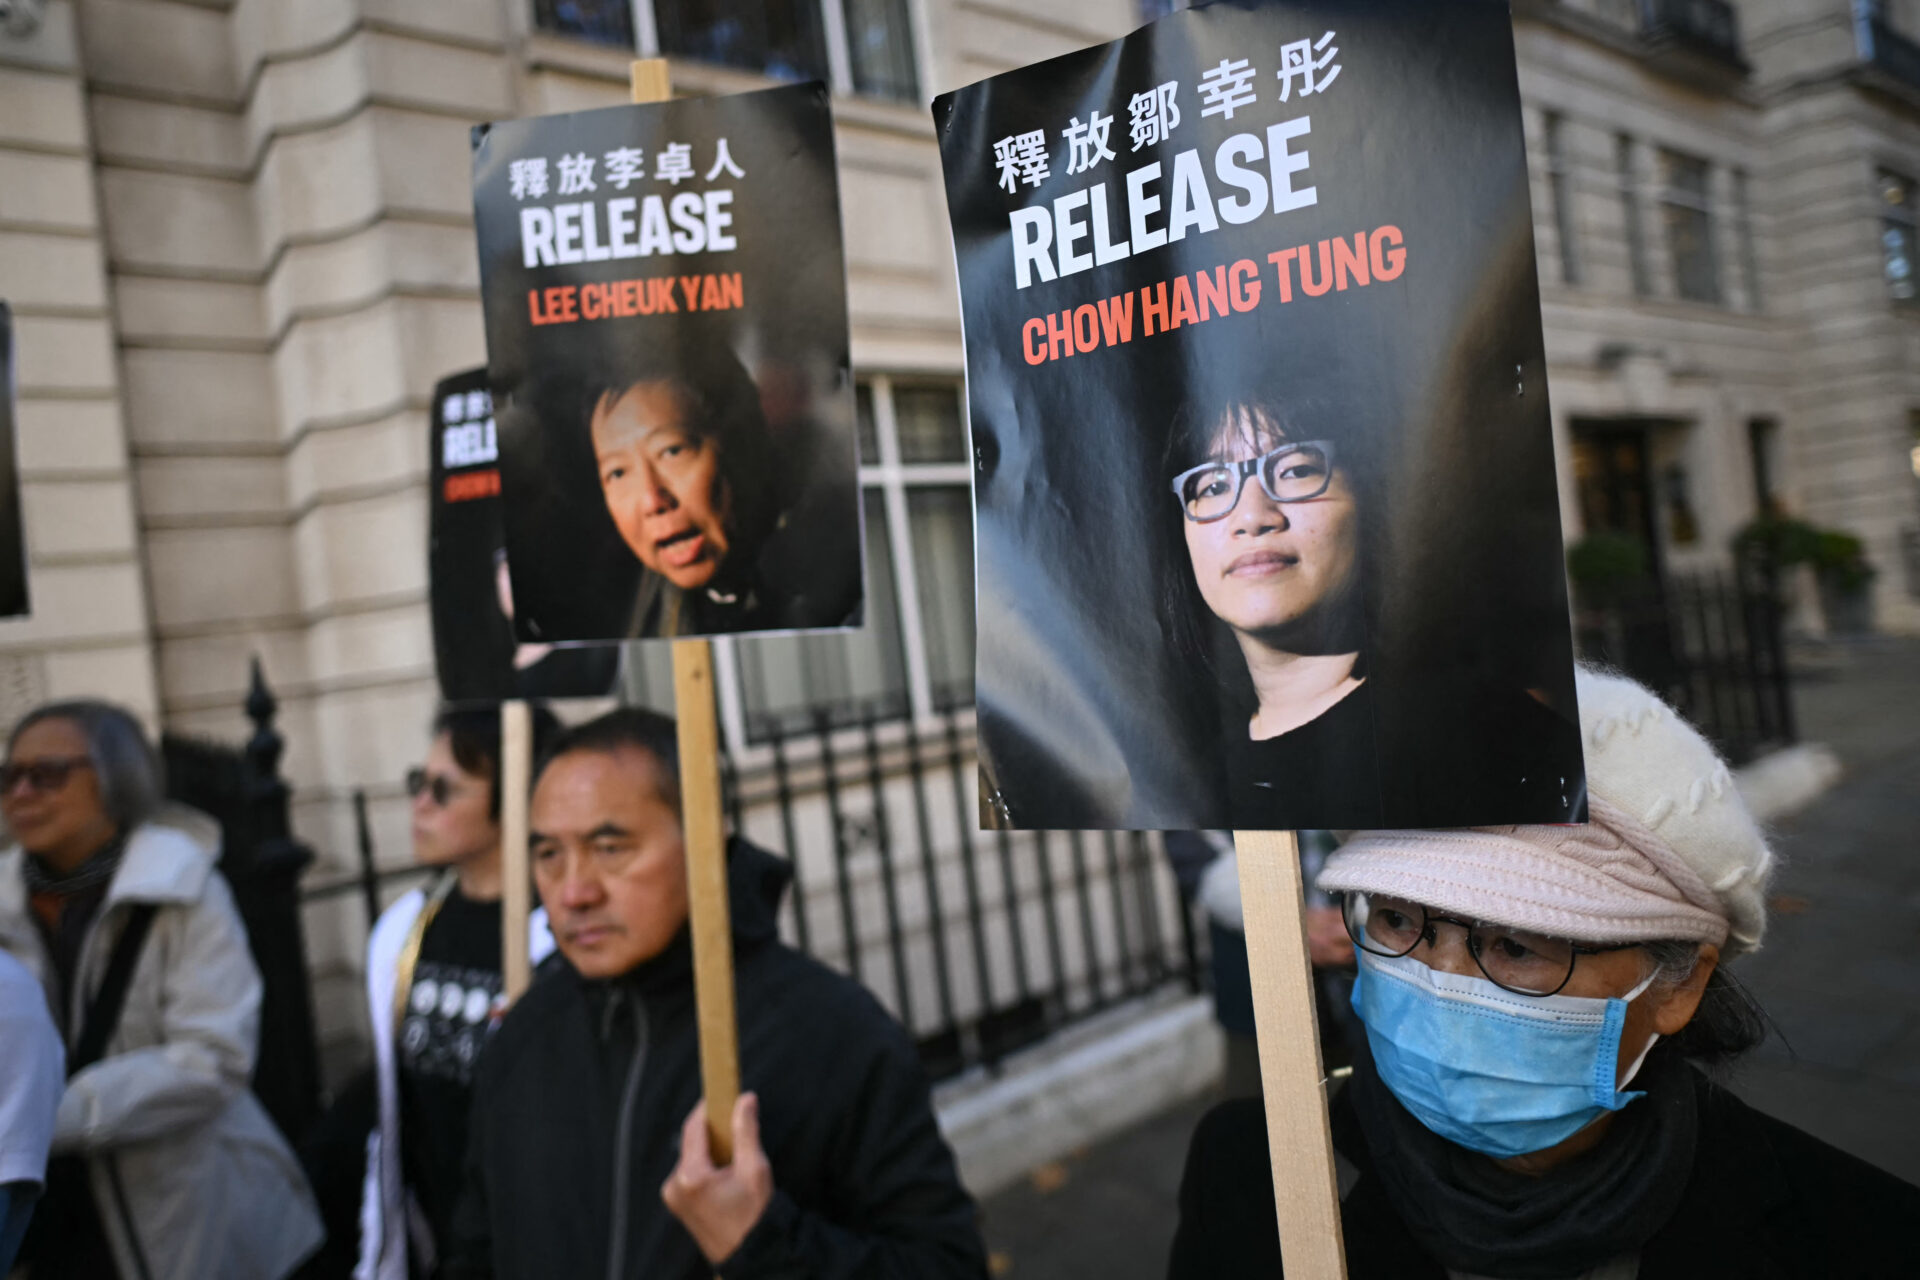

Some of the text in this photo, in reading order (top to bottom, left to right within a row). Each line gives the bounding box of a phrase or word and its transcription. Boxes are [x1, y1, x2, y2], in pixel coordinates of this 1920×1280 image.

[993, 30, 1343, 194] 釋放鄒幸彤
[508, 137, 747, 201] 釋放李卓人
[1009, 115, 1318, 291] RELEASE
[519, 189, 737, 268] RELEASE
[528, 272, 744, 326] LEE CHEUK YAN
[1022, 225, 1408, 366] CHOW HANG TUNG
